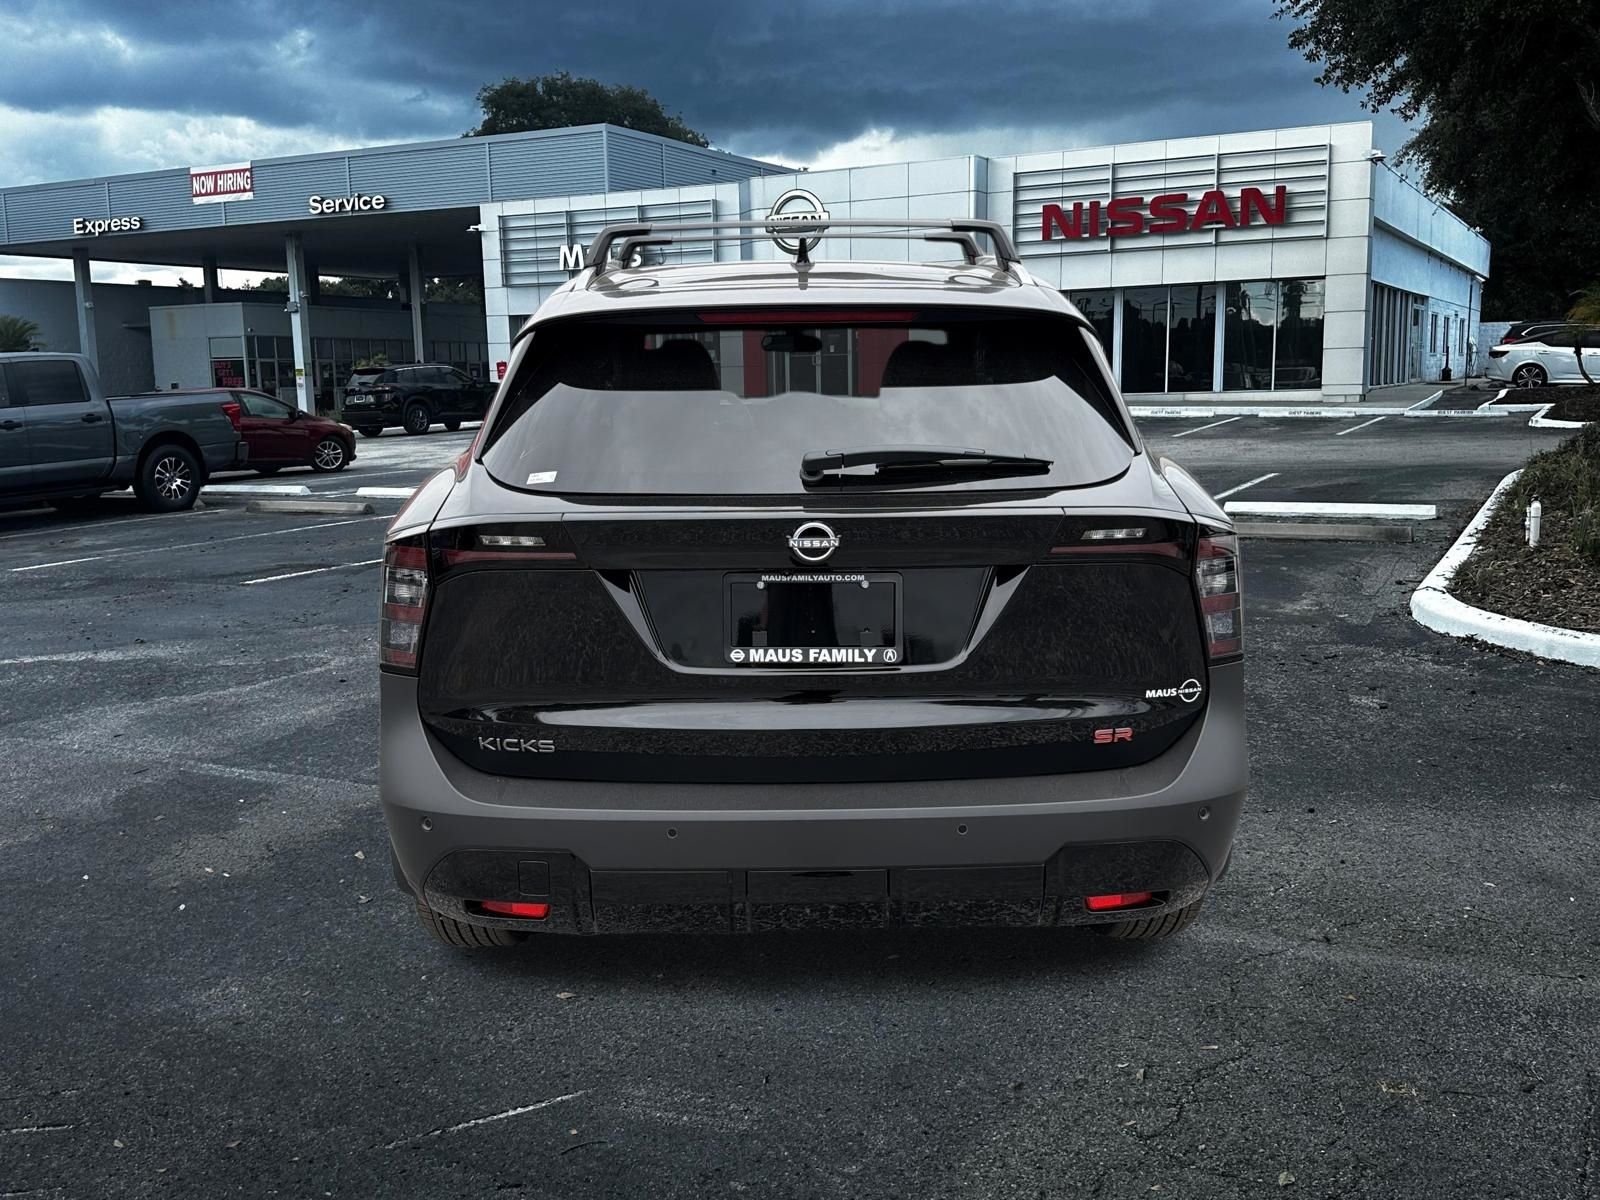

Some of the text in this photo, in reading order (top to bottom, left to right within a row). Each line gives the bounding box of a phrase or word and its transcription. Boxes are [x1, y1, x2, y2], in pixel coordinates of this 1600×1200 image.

[192, 171, 251, 195] NOW HIRING
[308, 193, 385, 215] Service
[1042, 185, 1287, 241] NISSAN
[73, 216, 141, 236] Express
[222, 377, 244, 386] FREE
[789, 539, 840, 548] NISSAN
[761, 574, 866, 582] MAUSFAMILYAUTO.COM
[749, 648, 877, 663] MAUS FAMILY
[1145, 687, 1178, 698] MAUS
[1093, 727, 1133, 744] SR
[478, 736, 555, 753] KICKS
